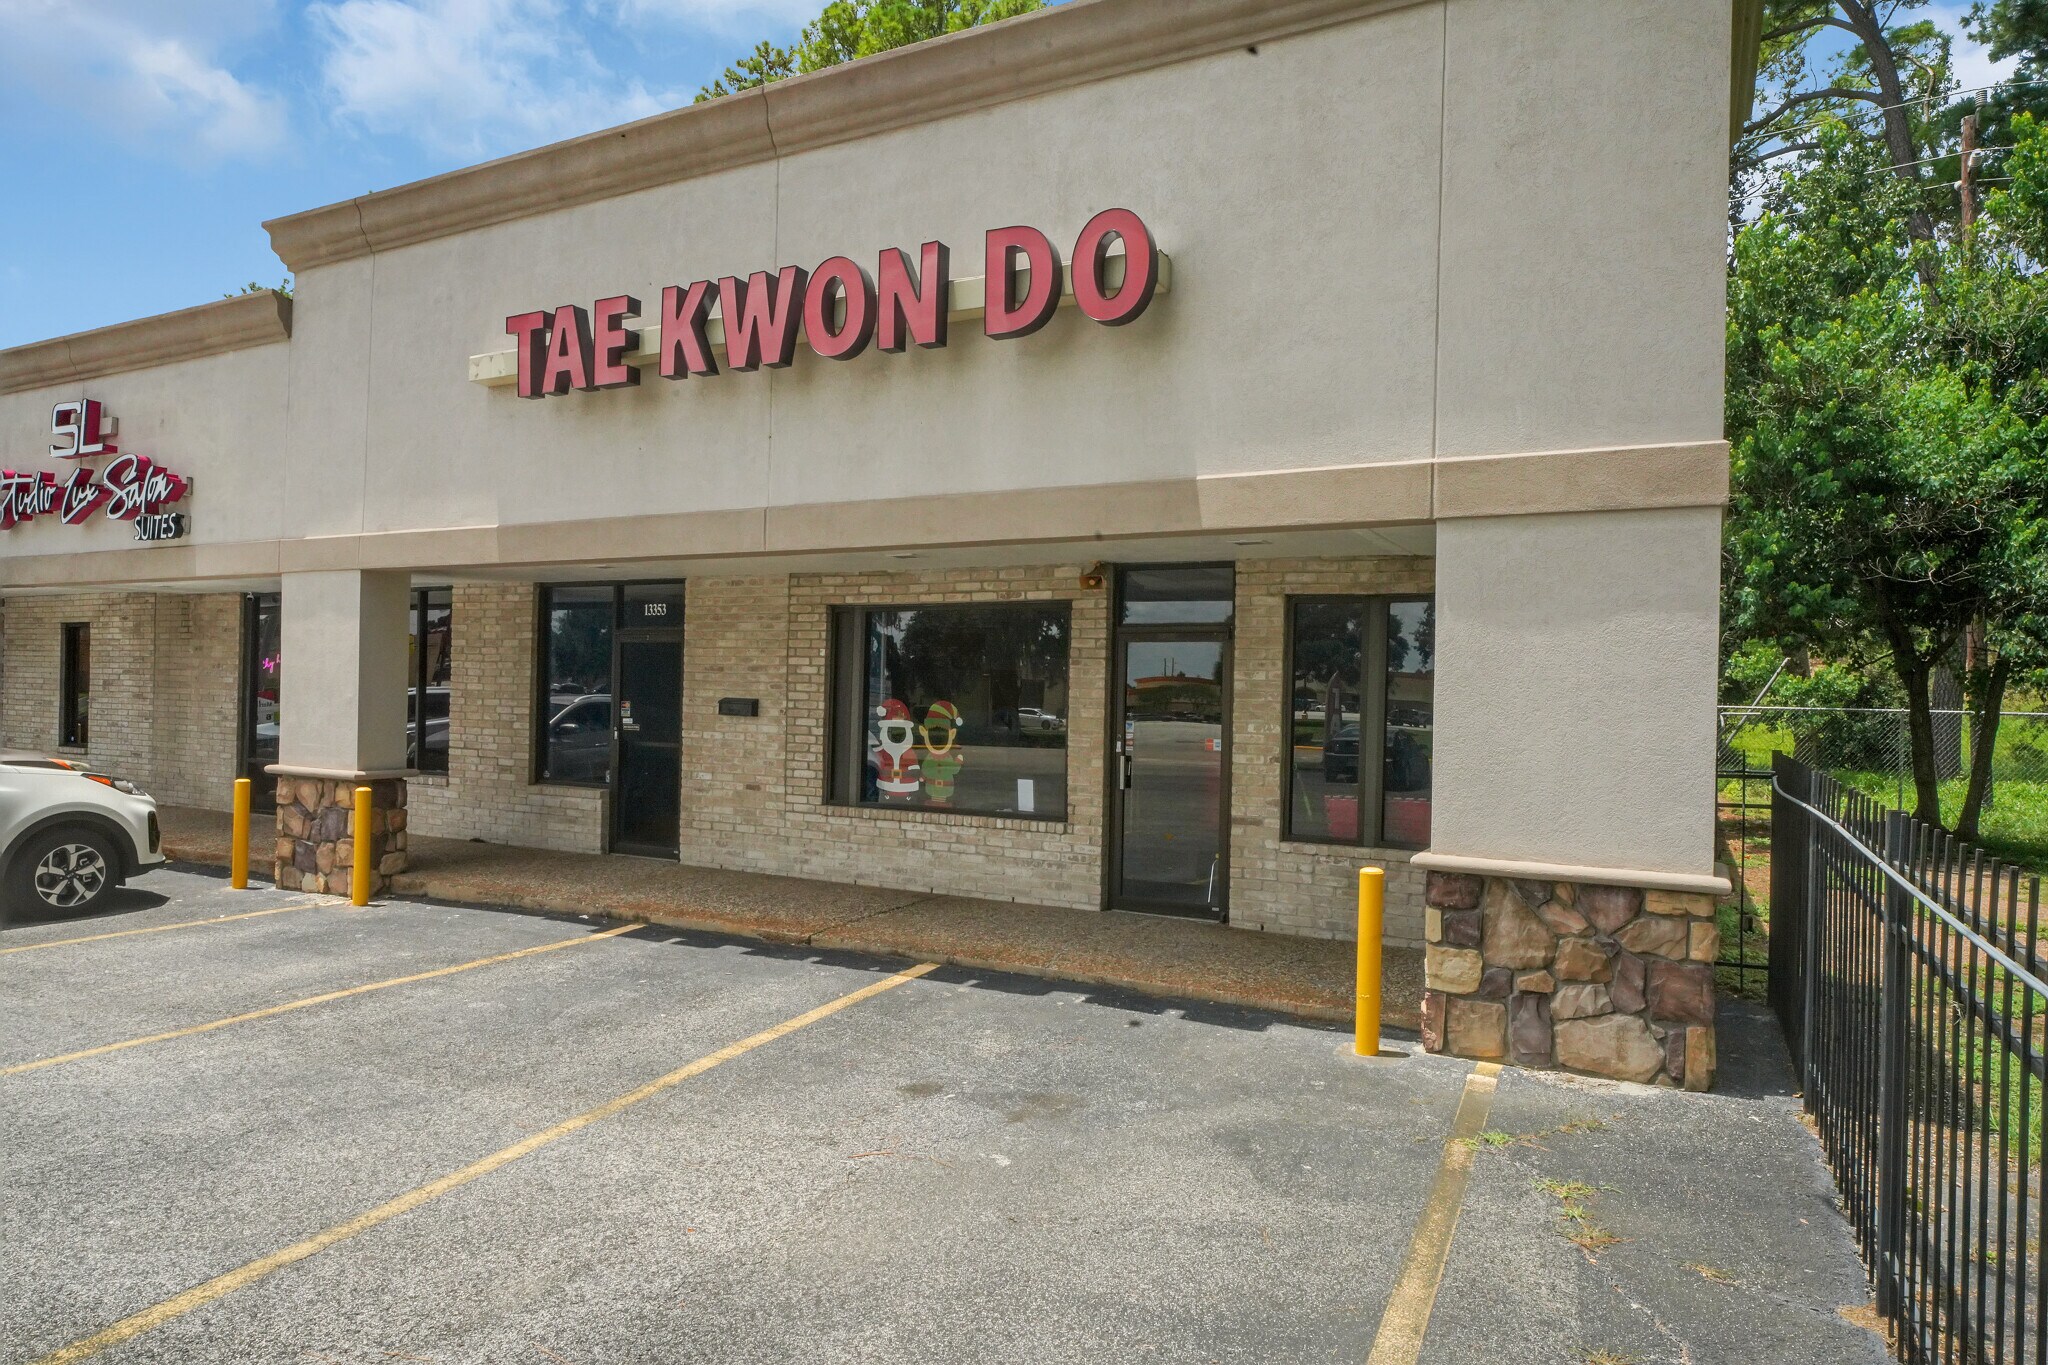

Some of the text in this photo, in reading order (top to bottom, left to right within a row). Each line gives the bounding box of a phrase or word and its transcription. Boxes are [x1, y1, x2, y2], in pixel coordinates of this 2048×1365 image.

[506, 207, 1159, 398] TAE KWON DO
[50, 398, 104, 458] SL
[0, 453, 173, 524] tudio Lux Salon
[134, 513, 176, 541] SUITES
[644, 603, 667, 616] 13353
